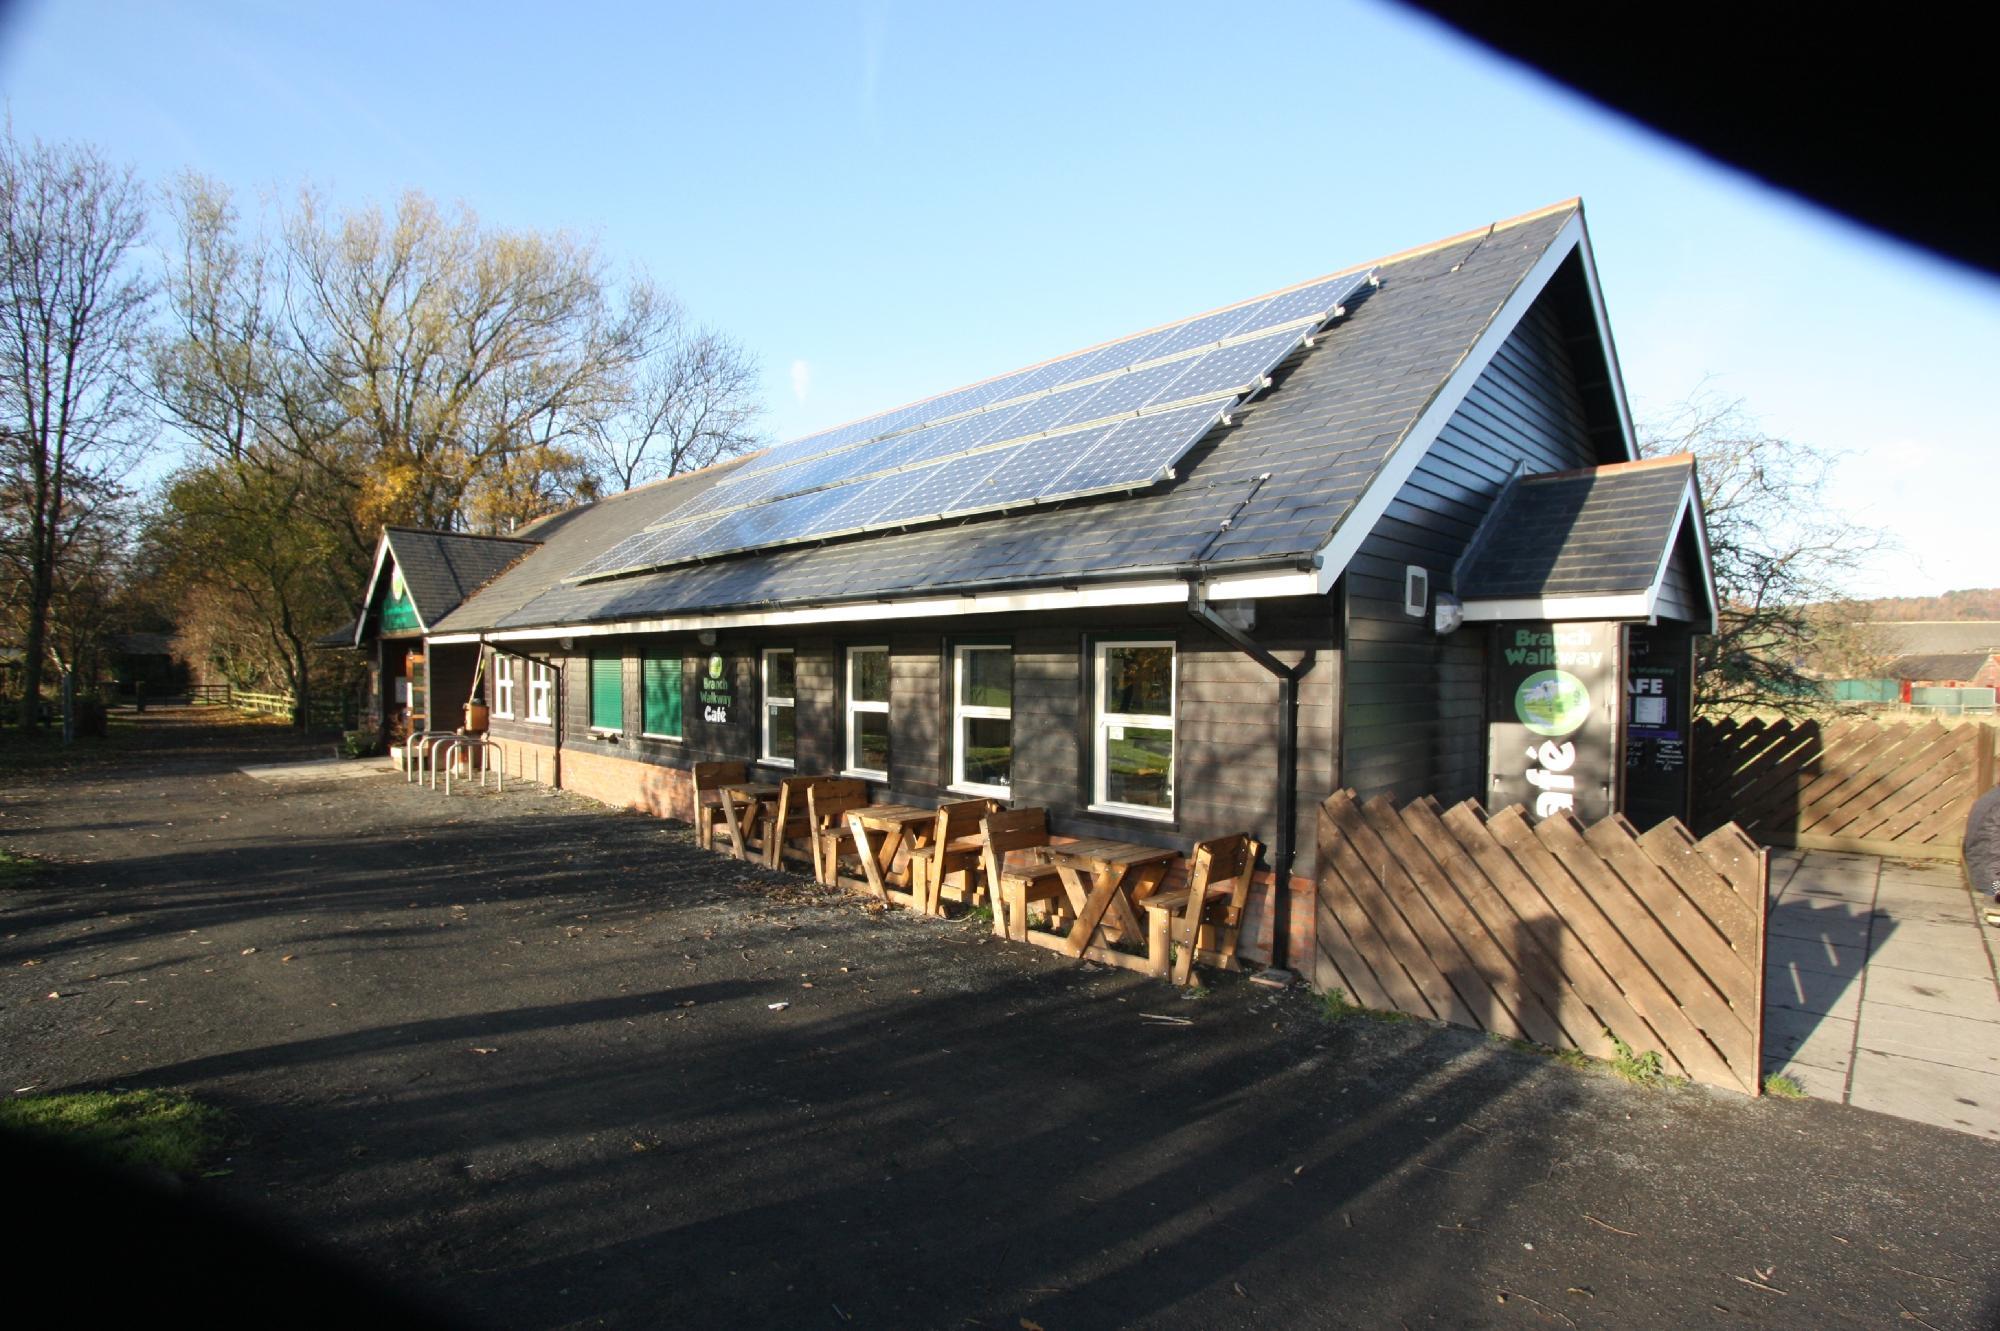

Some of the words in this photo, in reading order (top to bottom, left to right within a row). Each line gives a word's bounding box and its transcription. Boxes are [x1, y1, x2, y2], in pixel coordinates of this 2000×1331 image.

[1515, 628, 1592, 647] Branch
[1504, 647, 1603, 668] Walkway
[704, 705, 727, 723] Café
